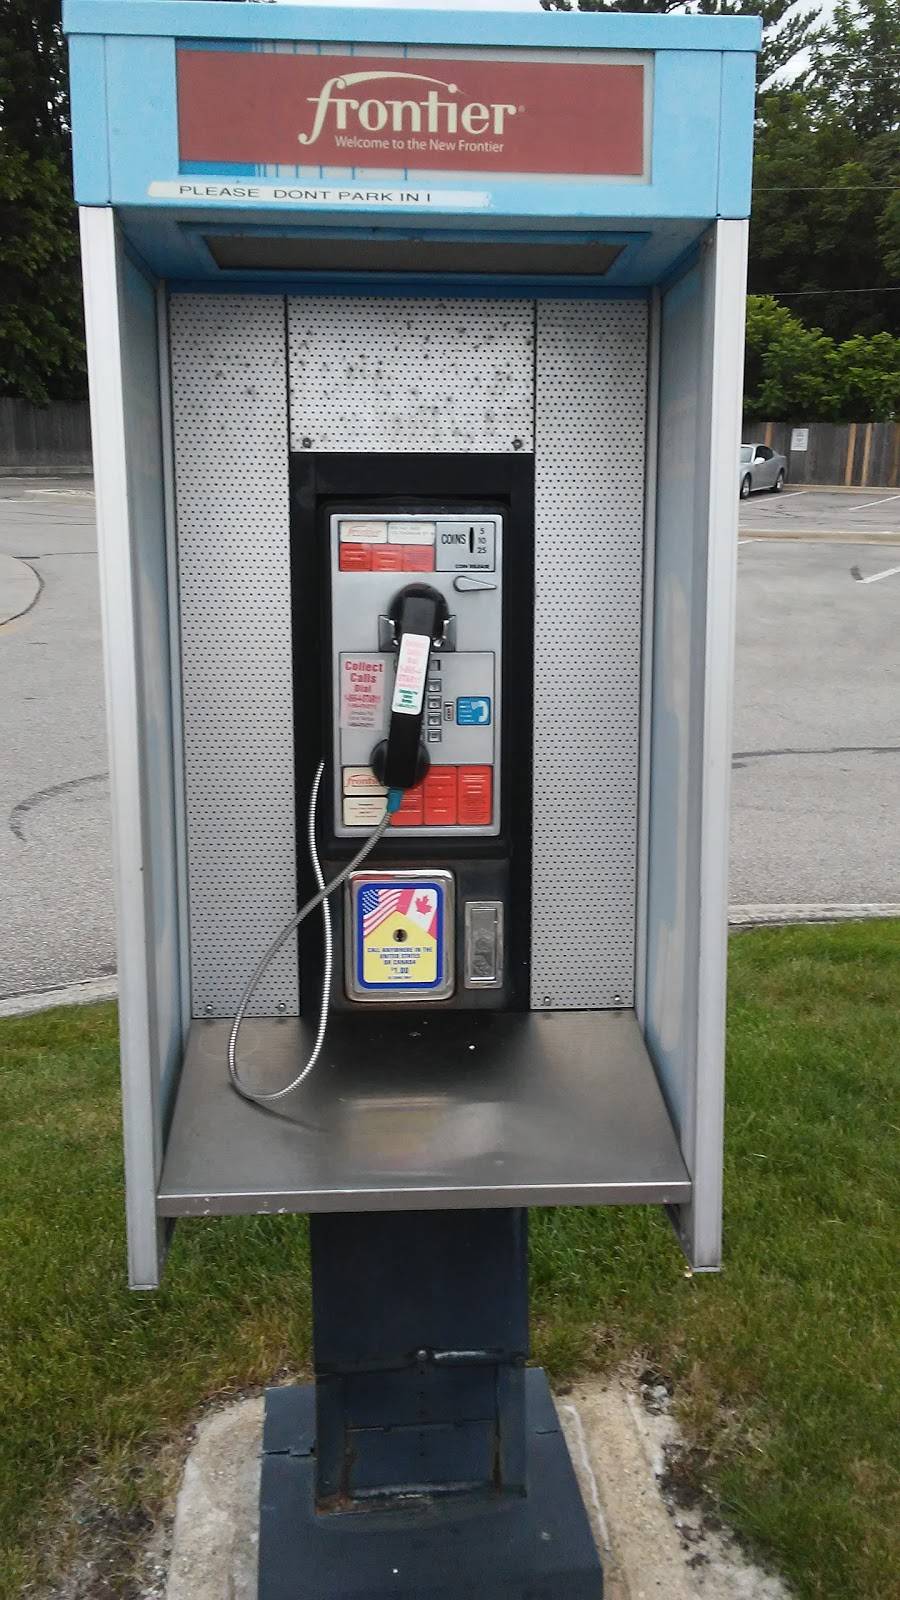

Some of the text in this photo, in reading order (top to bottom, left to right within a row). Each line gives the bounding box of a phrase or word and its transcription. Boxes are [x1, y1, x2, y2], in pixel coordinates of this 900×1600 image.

[298, 71, 517, 145] frontier
[335, 136, 504, 153] Welcome to the New Frontier
[179, 185, 260, 198] PLEASE
[273, 189, 330, 201] DONT
[338, 191, 393, 203] PARK
[400, 192, 420, 202] IN
[480, 527, 485, 535] 5
[441, 533, 467, 545] COINS
[477, 546, 487, 554] 25
[345, 660, 383, 673] Collect
[351, 672, 377, 684] Calls
